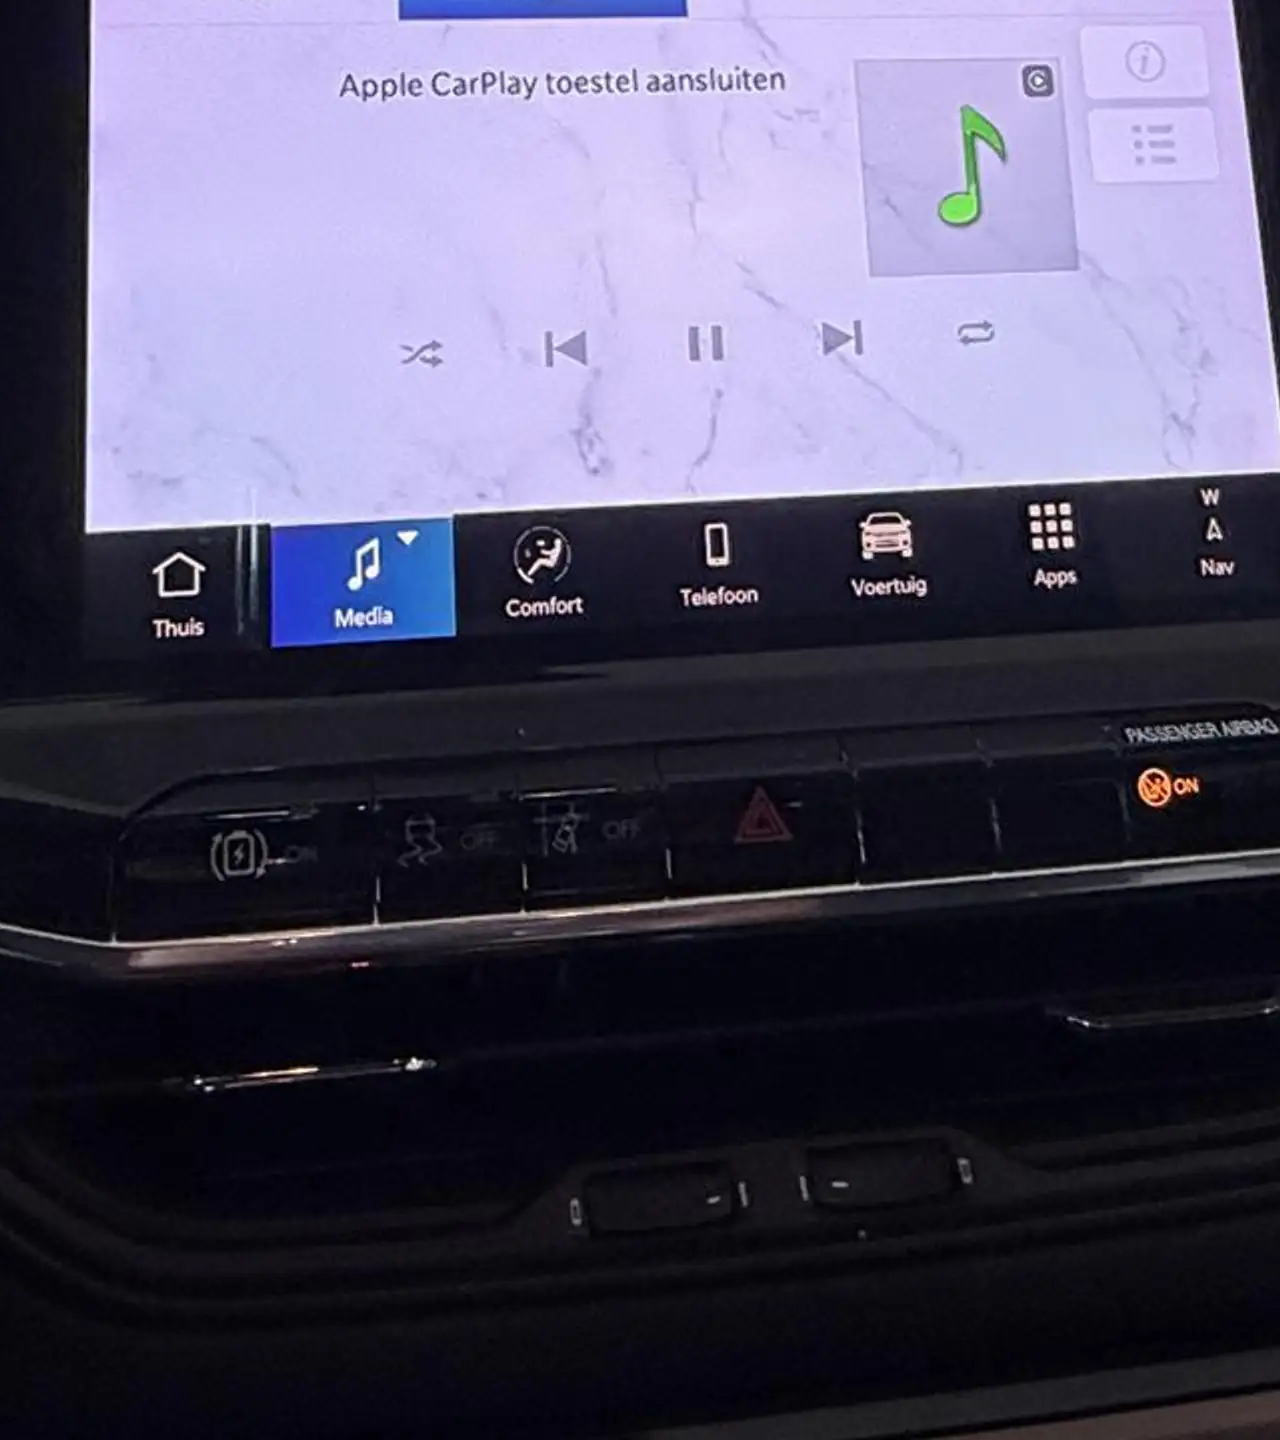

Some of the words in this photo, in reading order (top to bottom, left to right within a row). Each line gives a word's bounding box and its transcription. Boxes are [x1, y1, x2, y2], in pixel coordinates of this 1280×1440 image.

[339, 72, 421, 101] Apple
[431, 70, 537, 100] CarPlay
[546, 68, 637, 95] toestel
[646, 65, 787, 93] aansluiten
[1200, 488, 1219, 507] W
[1034, 567, 1077, 589] Apps
[1200, 559, 1234, 576] Nav
[680, 587, 758, 607] Telefoon
[851, 575, 927, 598] Voertuig
[506, 595, 584, 618] Comfort
[153, 617, 204, 638] Thuis
[335, 608, 393, 628] Media
[1125, 722, 1219, 744] PASSENGER
[1221, 717, 1279, 737] AIRBAG
[1174, 778, 1199, 795] ON
